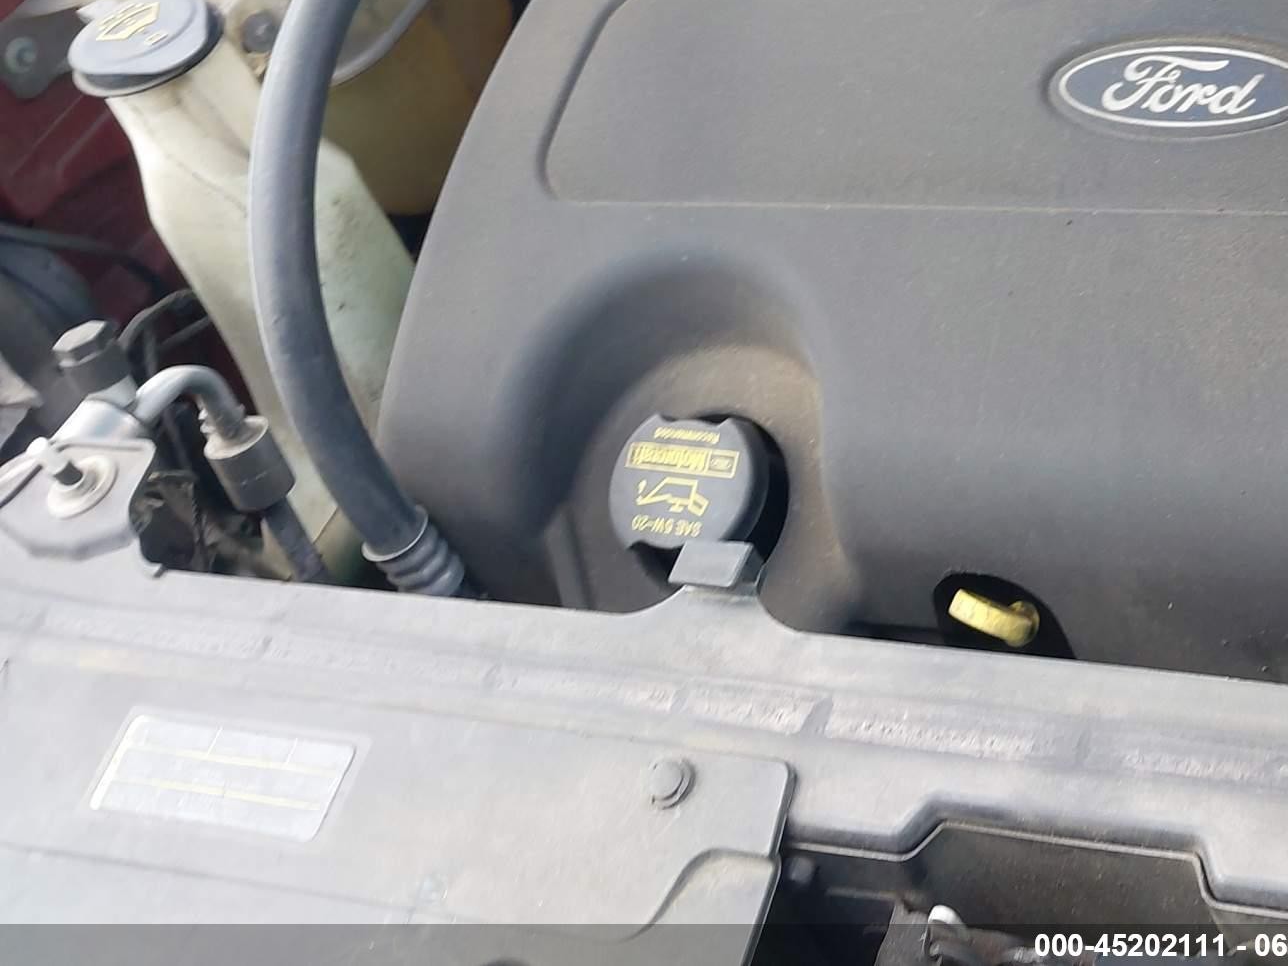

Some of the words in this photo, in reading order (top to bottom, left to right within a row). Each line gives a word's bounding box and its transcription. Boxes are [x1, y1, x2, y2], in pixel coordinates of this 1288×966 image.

[1101, 54, 1264, 115] Ford
[631, 514, 675, 535] 5W-20
[674, 519, 703, 538] SAE
